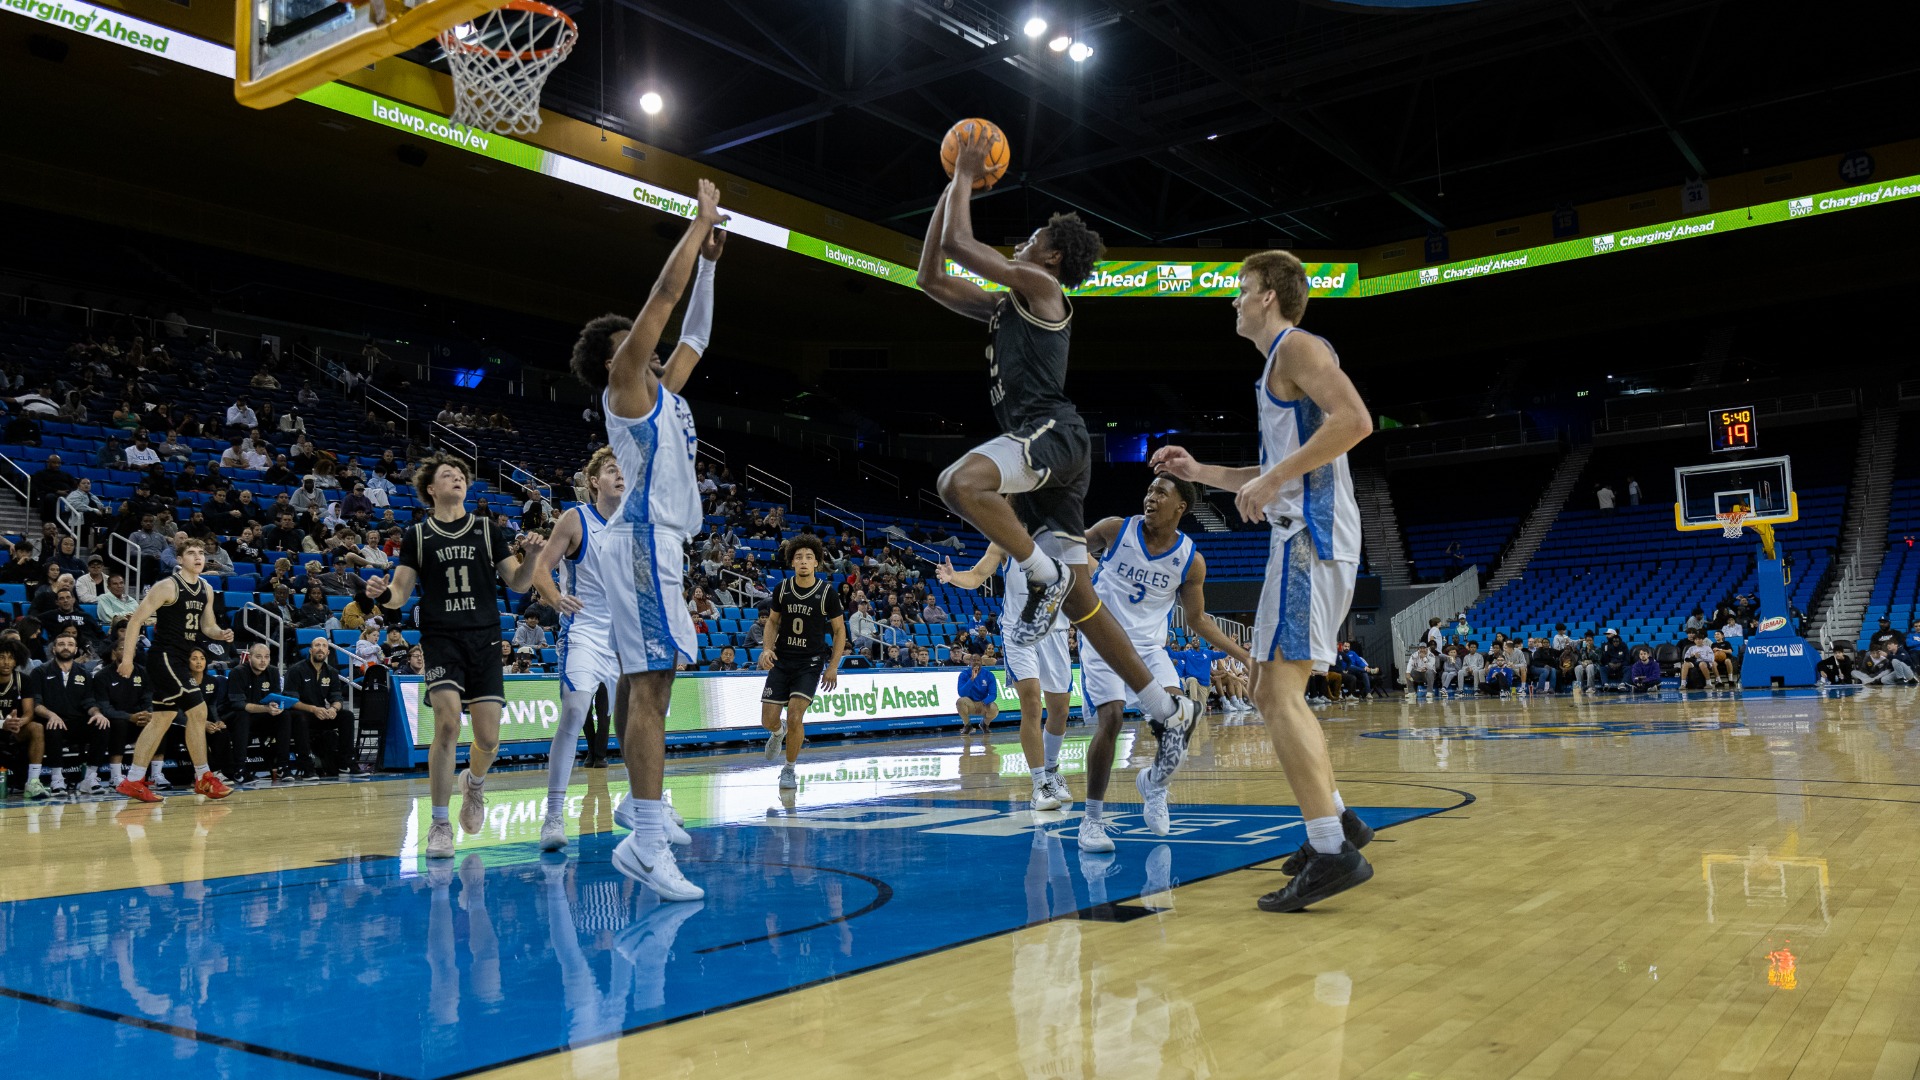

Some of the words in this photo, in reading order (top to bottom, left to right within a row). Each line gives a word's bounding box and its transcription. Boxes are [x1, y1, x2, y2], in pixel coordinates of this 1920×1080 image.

[0, 0, 91, 32] arging
[93, 18, 170, 54] Ahead
[372, 100, 489, 151] ladwp.com/ev
[1841, 156, 1872, 180] 42
[633, 187, 690, 217] Charging
[1819, 191, 1880, 210] Charging
[1790, 206, 1813, 217] DWP
[1620, 231, 1674, 247] Charging
[1675, 220, 1715, 237] Ahead
[1594, 243, 1614, 253] DWP
[825, 245, 890, 276] ladwp.com/ev
[1443, 264, 1491, 280] Charging
[1492, 255, 1528, 271] Ahead
[1085, 271, 1148, 288] Ahead
[1158, 266, 1178, 278] LA
[1420, 275, 1438, 285] DWP
[1159, 280, 1192, 292] DWP
[1722, 411, 1750, 425] 5:40
[1728, 424, 1748, 445] 19
[436, 545, 476, 563] NOTRE
[445, 566, 471, 594] 11
[1117, 562, 1170, 588] EAGLES
[1128, 583, 1146, 605] 3
[445, 597, 476, 612] DAME
[787, 603, 813, 616] NOTRE
[185, 612, 200, 630] 21
[792, 617, 804, 635] 0
[1759, 618, 1784, 633] LIBMAN
[787, 636, 807, 648] DAME
[1748, 645, 1788, 655] WESCOM
[806, 687, 878, 717] arging
[881, 685, 940, 710] Ahead
